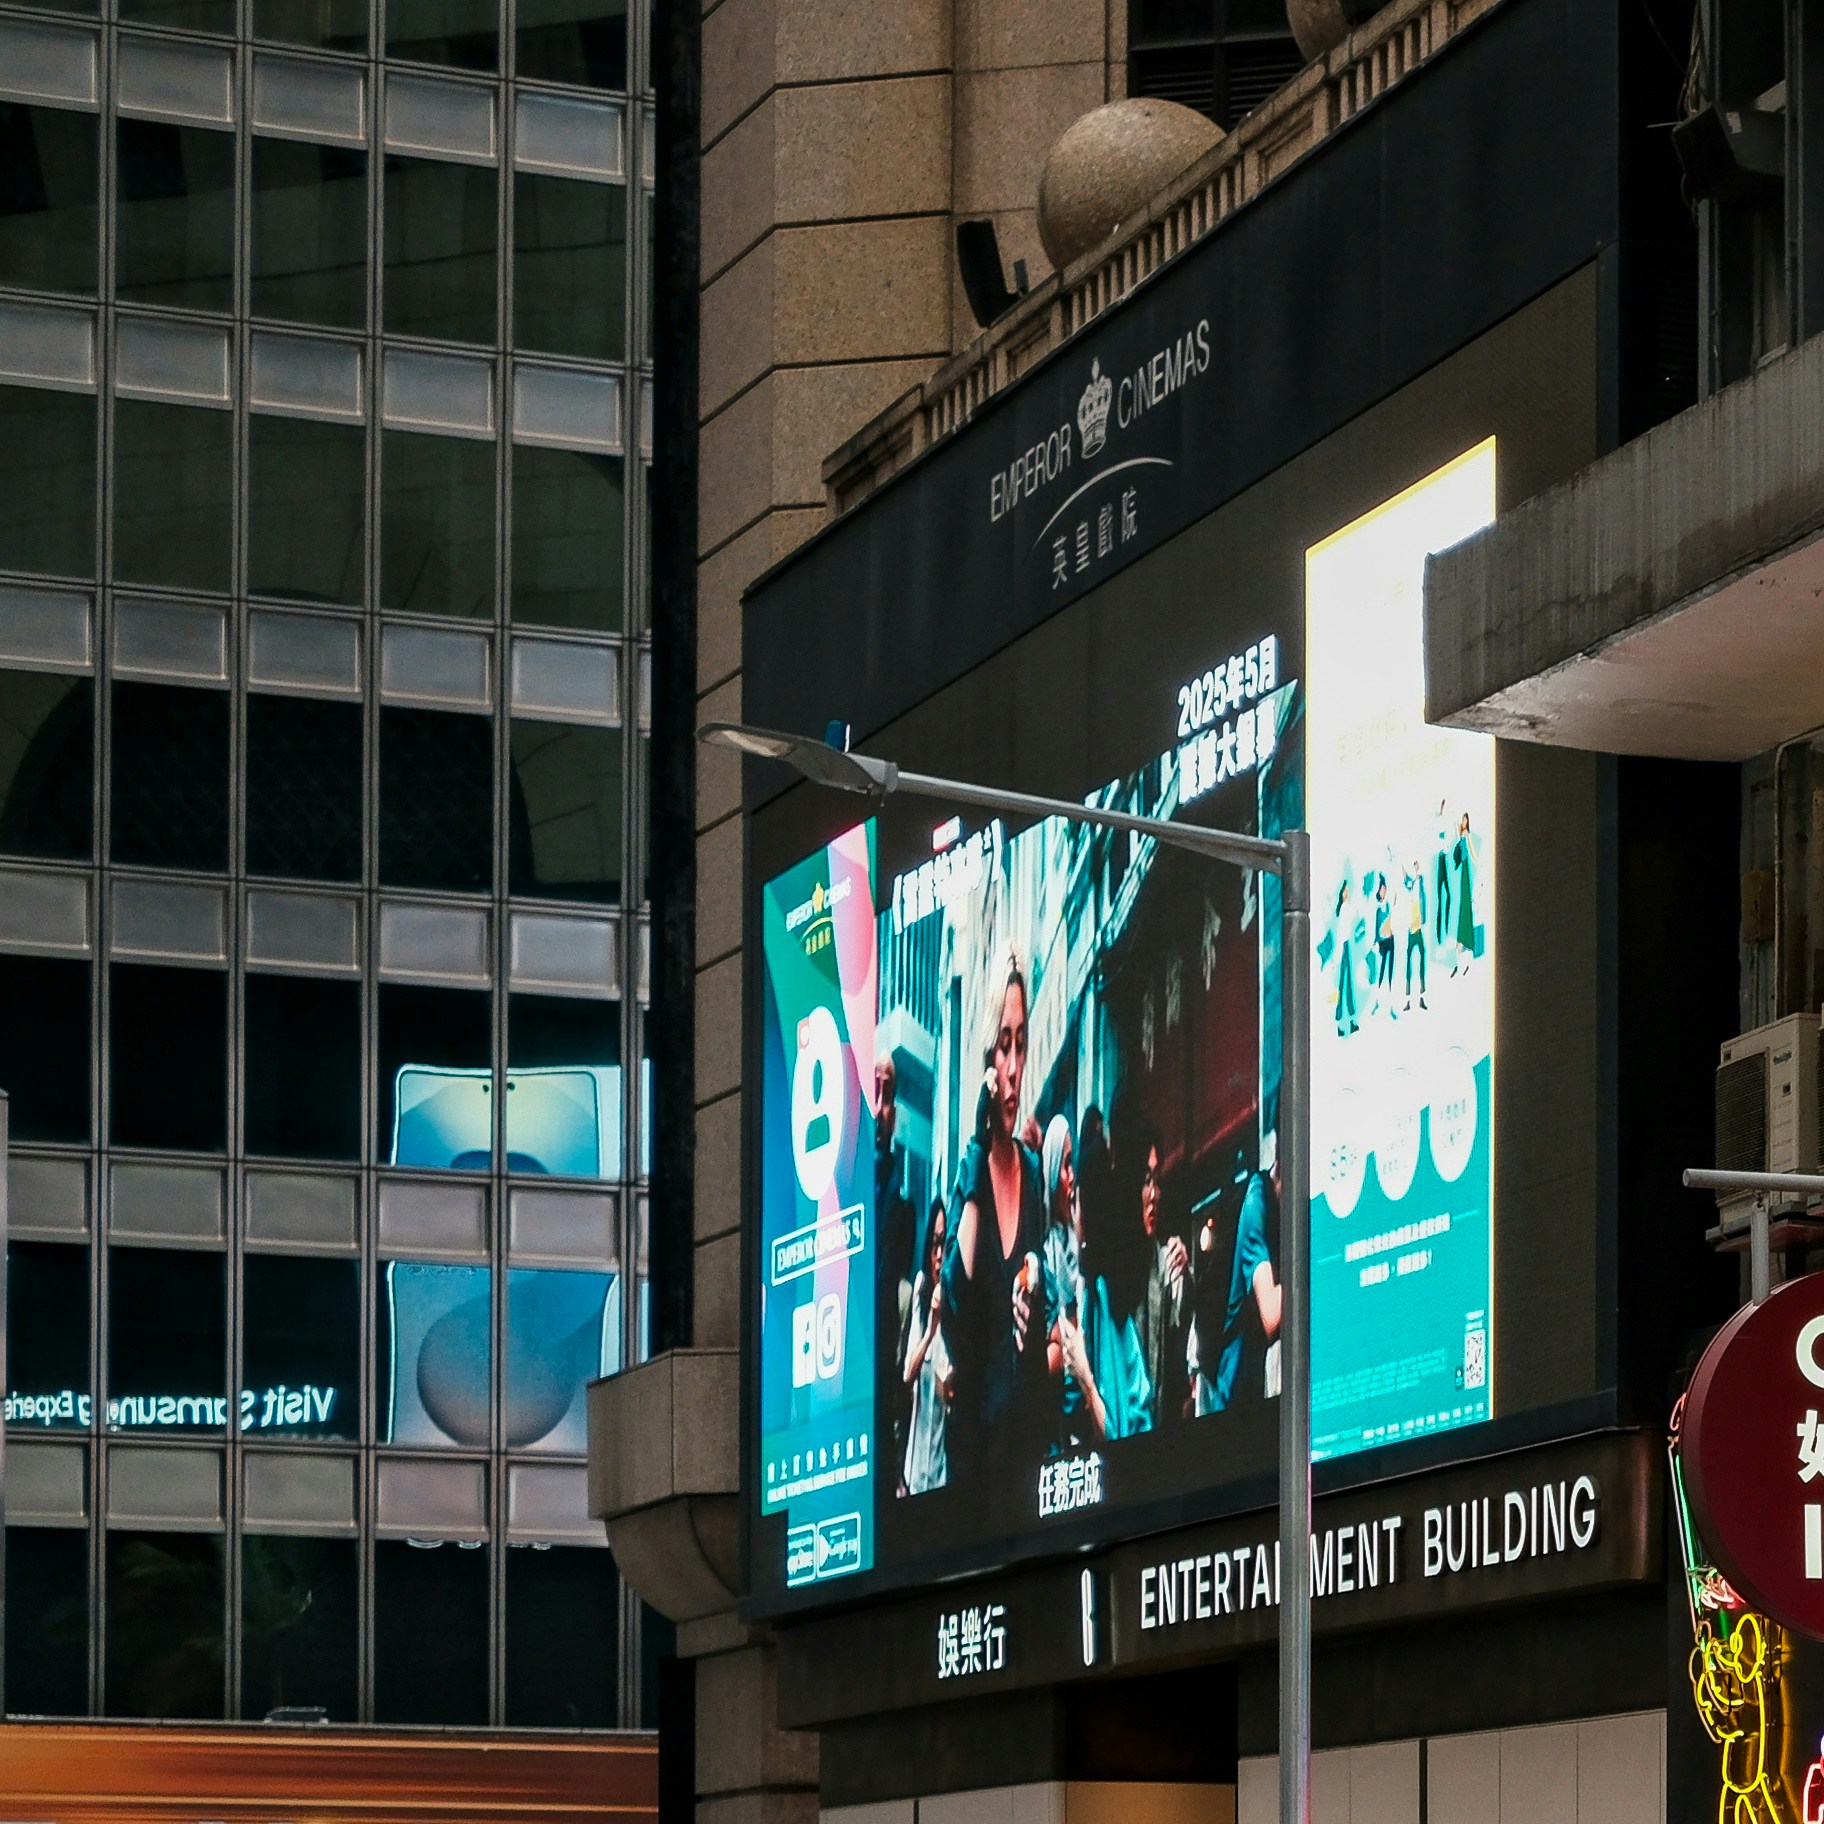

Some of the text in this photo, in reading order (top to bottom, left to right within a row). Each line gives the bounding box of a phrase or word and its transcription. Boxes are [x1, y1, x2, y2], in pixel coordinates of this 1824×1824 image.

[990, 319, 1211, 523] EMPEROR CINEMAS
[1177, 633, 1277, 738] 2025年5月
[1037, 1452, 1101, 1518] 任務完成
[1139, 1475, 1597, 1630] ENTERTAIMENT BUILDING
[937, 1604, 1007, 1680] 娛樂行
